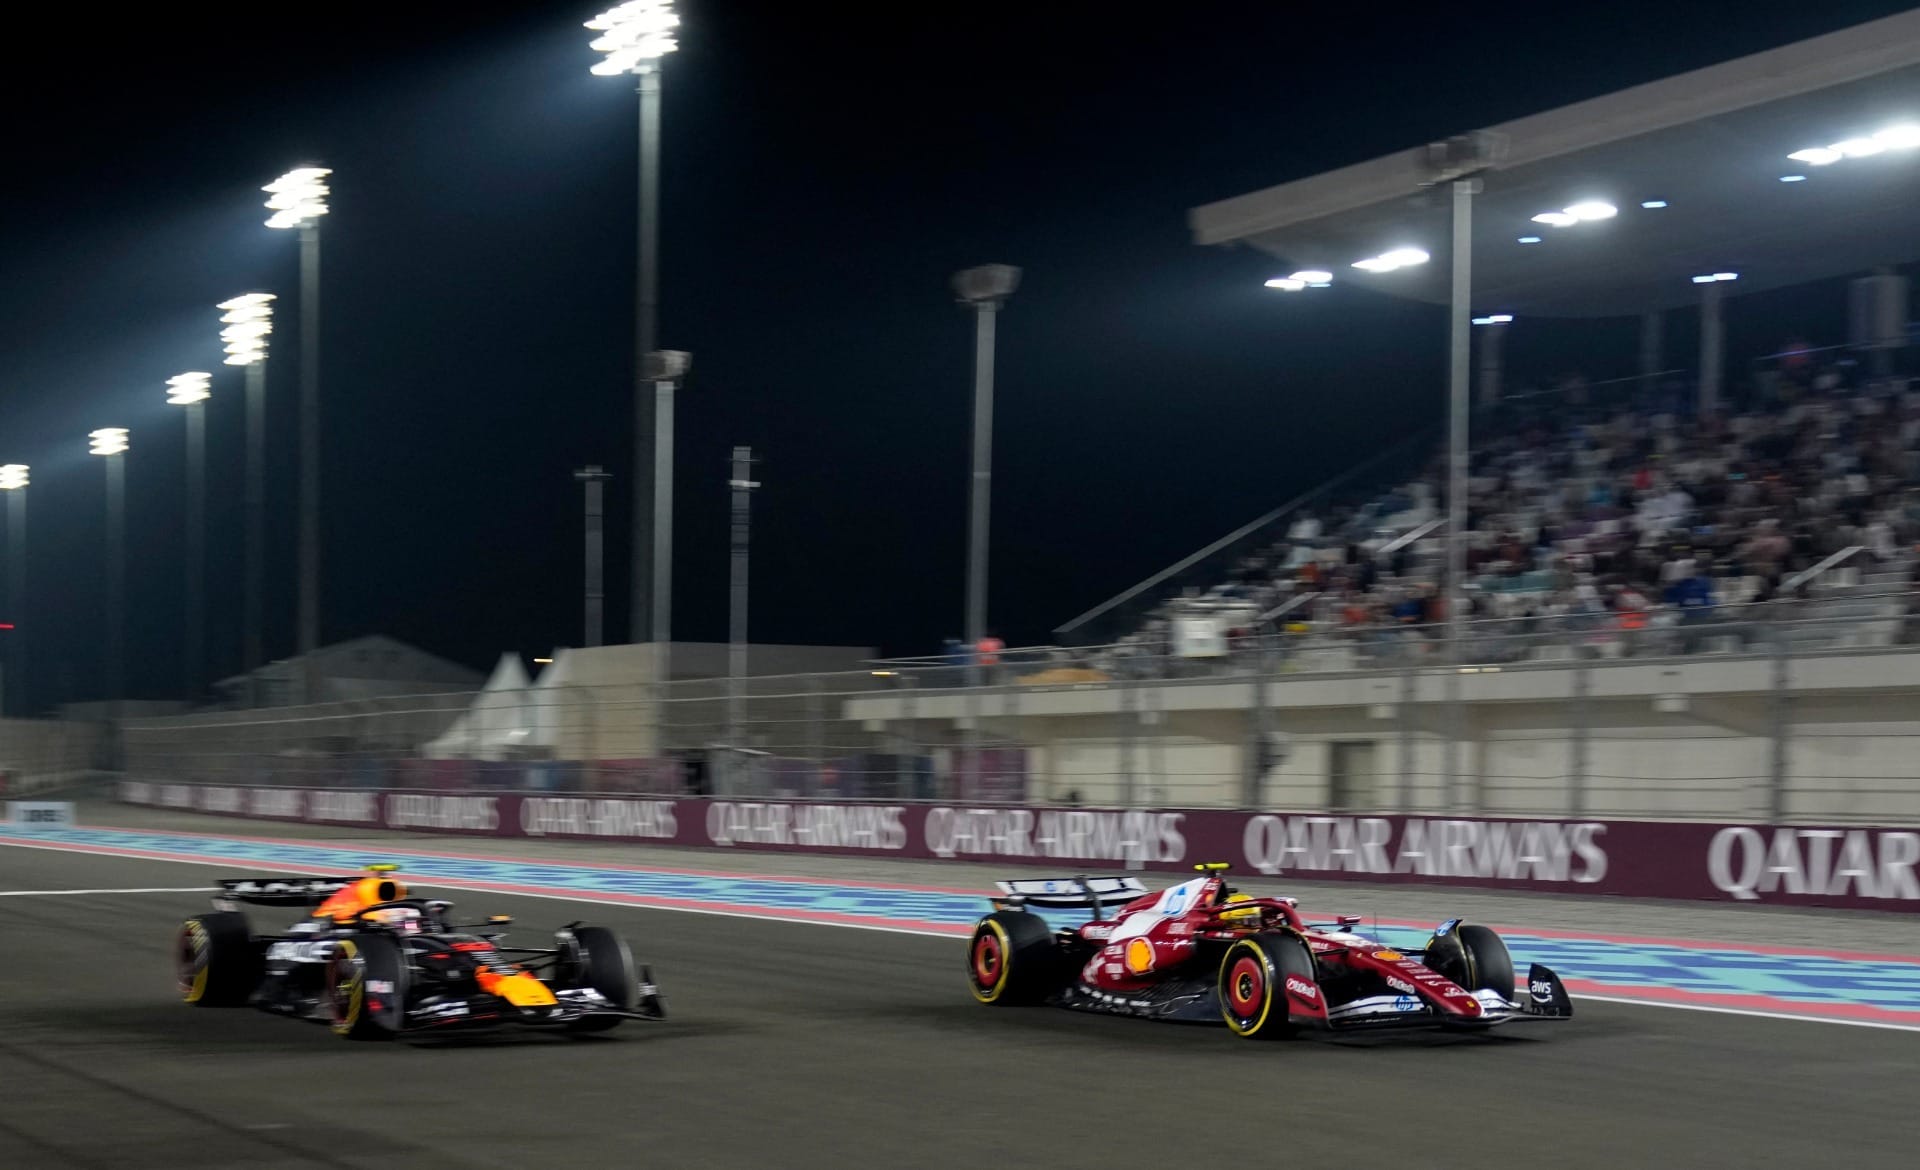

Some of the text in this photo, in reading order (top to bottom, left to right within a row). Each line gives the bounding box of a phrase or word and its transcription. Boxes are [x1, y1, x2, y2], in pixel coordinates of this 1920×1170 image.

[924, 807, 1187, 863] QATAR AIRWAYS
[1243, 815, 1608, 883] QATAR AIRWAYS
[1706, 826, 1920, 899] QATAR
[1531, 980, 1552, 994] aws
